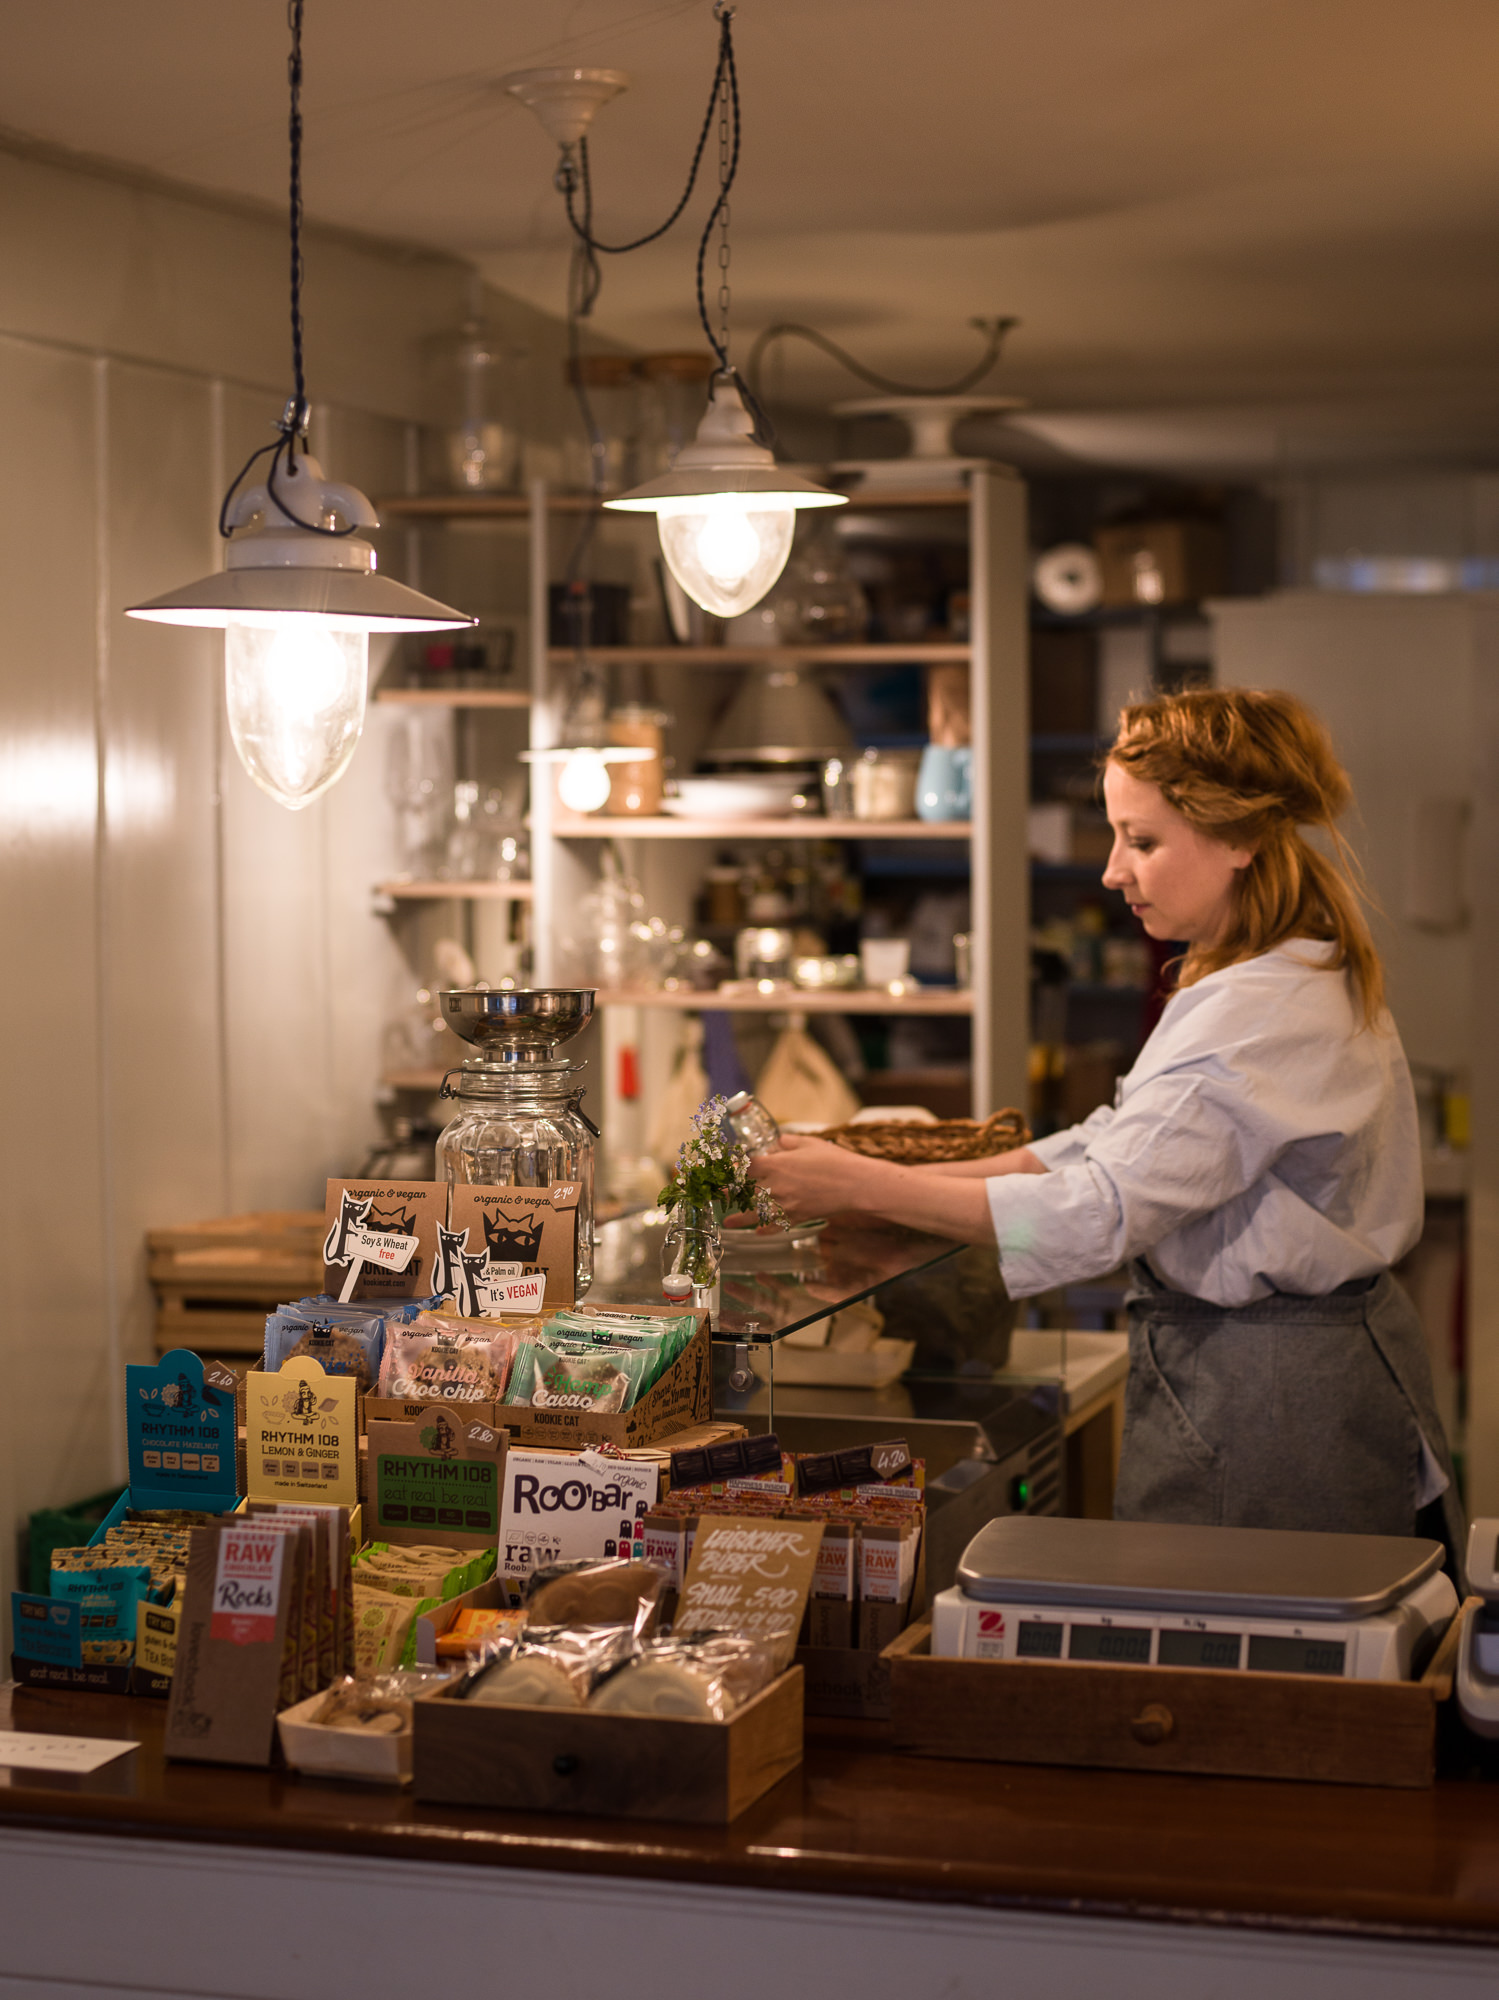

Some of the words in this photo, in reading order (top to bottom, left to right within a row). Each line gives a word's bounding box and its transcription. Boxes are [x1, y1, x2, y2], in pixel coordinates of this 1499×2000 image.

[396, 1191, 427, 1201] vegan
[474, 1195, 513, 1206] organic
[514, 1196, 523, 1204] &
[524, 1198, 552, 1208] vega
[554, 1186, 574, 1200] 2.40
[361, 1235, 375, 1248] Soy
[375, 1238, 382, 1246] &
[383, 1237, 408, 1250] Wheat
[379, 1248, 395, 1260] free
[491, 1267, 506, 1276] Palm
[507, 1267, 516, 1276] oil
[490, 1288, 505, 1302] It's
[506, 1282, 538, 1299] VEGAN
[281, 1324, 309, 1334] organic
[338, 1327, 364, 1336] vegan
[402, 1330, 433, 1340] organic
[465, 1335, 491, 1343] vegan
[556, 1330, 588, 1339] organic
[618, 1334, 644, 1343] vegan
[312, 1355, 349, 1374] hia
[408, 1362, 480, 1384] Vanilla
[208, 1371, 233, 1386] 2.60
[554, 1374, 615, 1400] Hemp
[392, 1378, 441, 1397] Choc
[443, 1383, 486, 1403] chip
[532, 1389, 596, 1409] Cacao
[404, 1404, 429, 1416] KOOK
[534, 1413, 562, 1425] KOOKIE
[564, 1415, 579, 1427] CAT
[141, 1422, 195, 1438] RHYTHM
[198, 1425, 220, 1439] 108
[261, 1430, 314, 1445] RHYTHM
[318, 1434, 339, 1447] 108
[468, 1426, 494, 1443] 2.80
[262, 1444, 295, 1456] LEMON
[297, 1447, 304, 1457] &
[305, 1447, 340, 1459] GINGER
[877, 1450, 905, 1470] 4.20
[384, 1460, 459, 1480] RHYTHM
[462, 1465, 492, 1483] 108
[613, 1472, 648, 1491] organic
[384, 1484, 408, 1500] eat
[410, 1486, 437, 1502] real
[440, 1487, 460, 1504] be
[462, 1490, 489, 1507] real
[225, 1543, 277, 1563] RAW
[504, 1544, 561, 1565] raw
[646, 1544, 677, 1560] RAW
[816, 1552, 847, 1566] RAW
[865, 1554, 897, 1569] RAW
[218, 1581, 273, 1610] Rocks
[685, 1581, 743, 1607] SMALL
